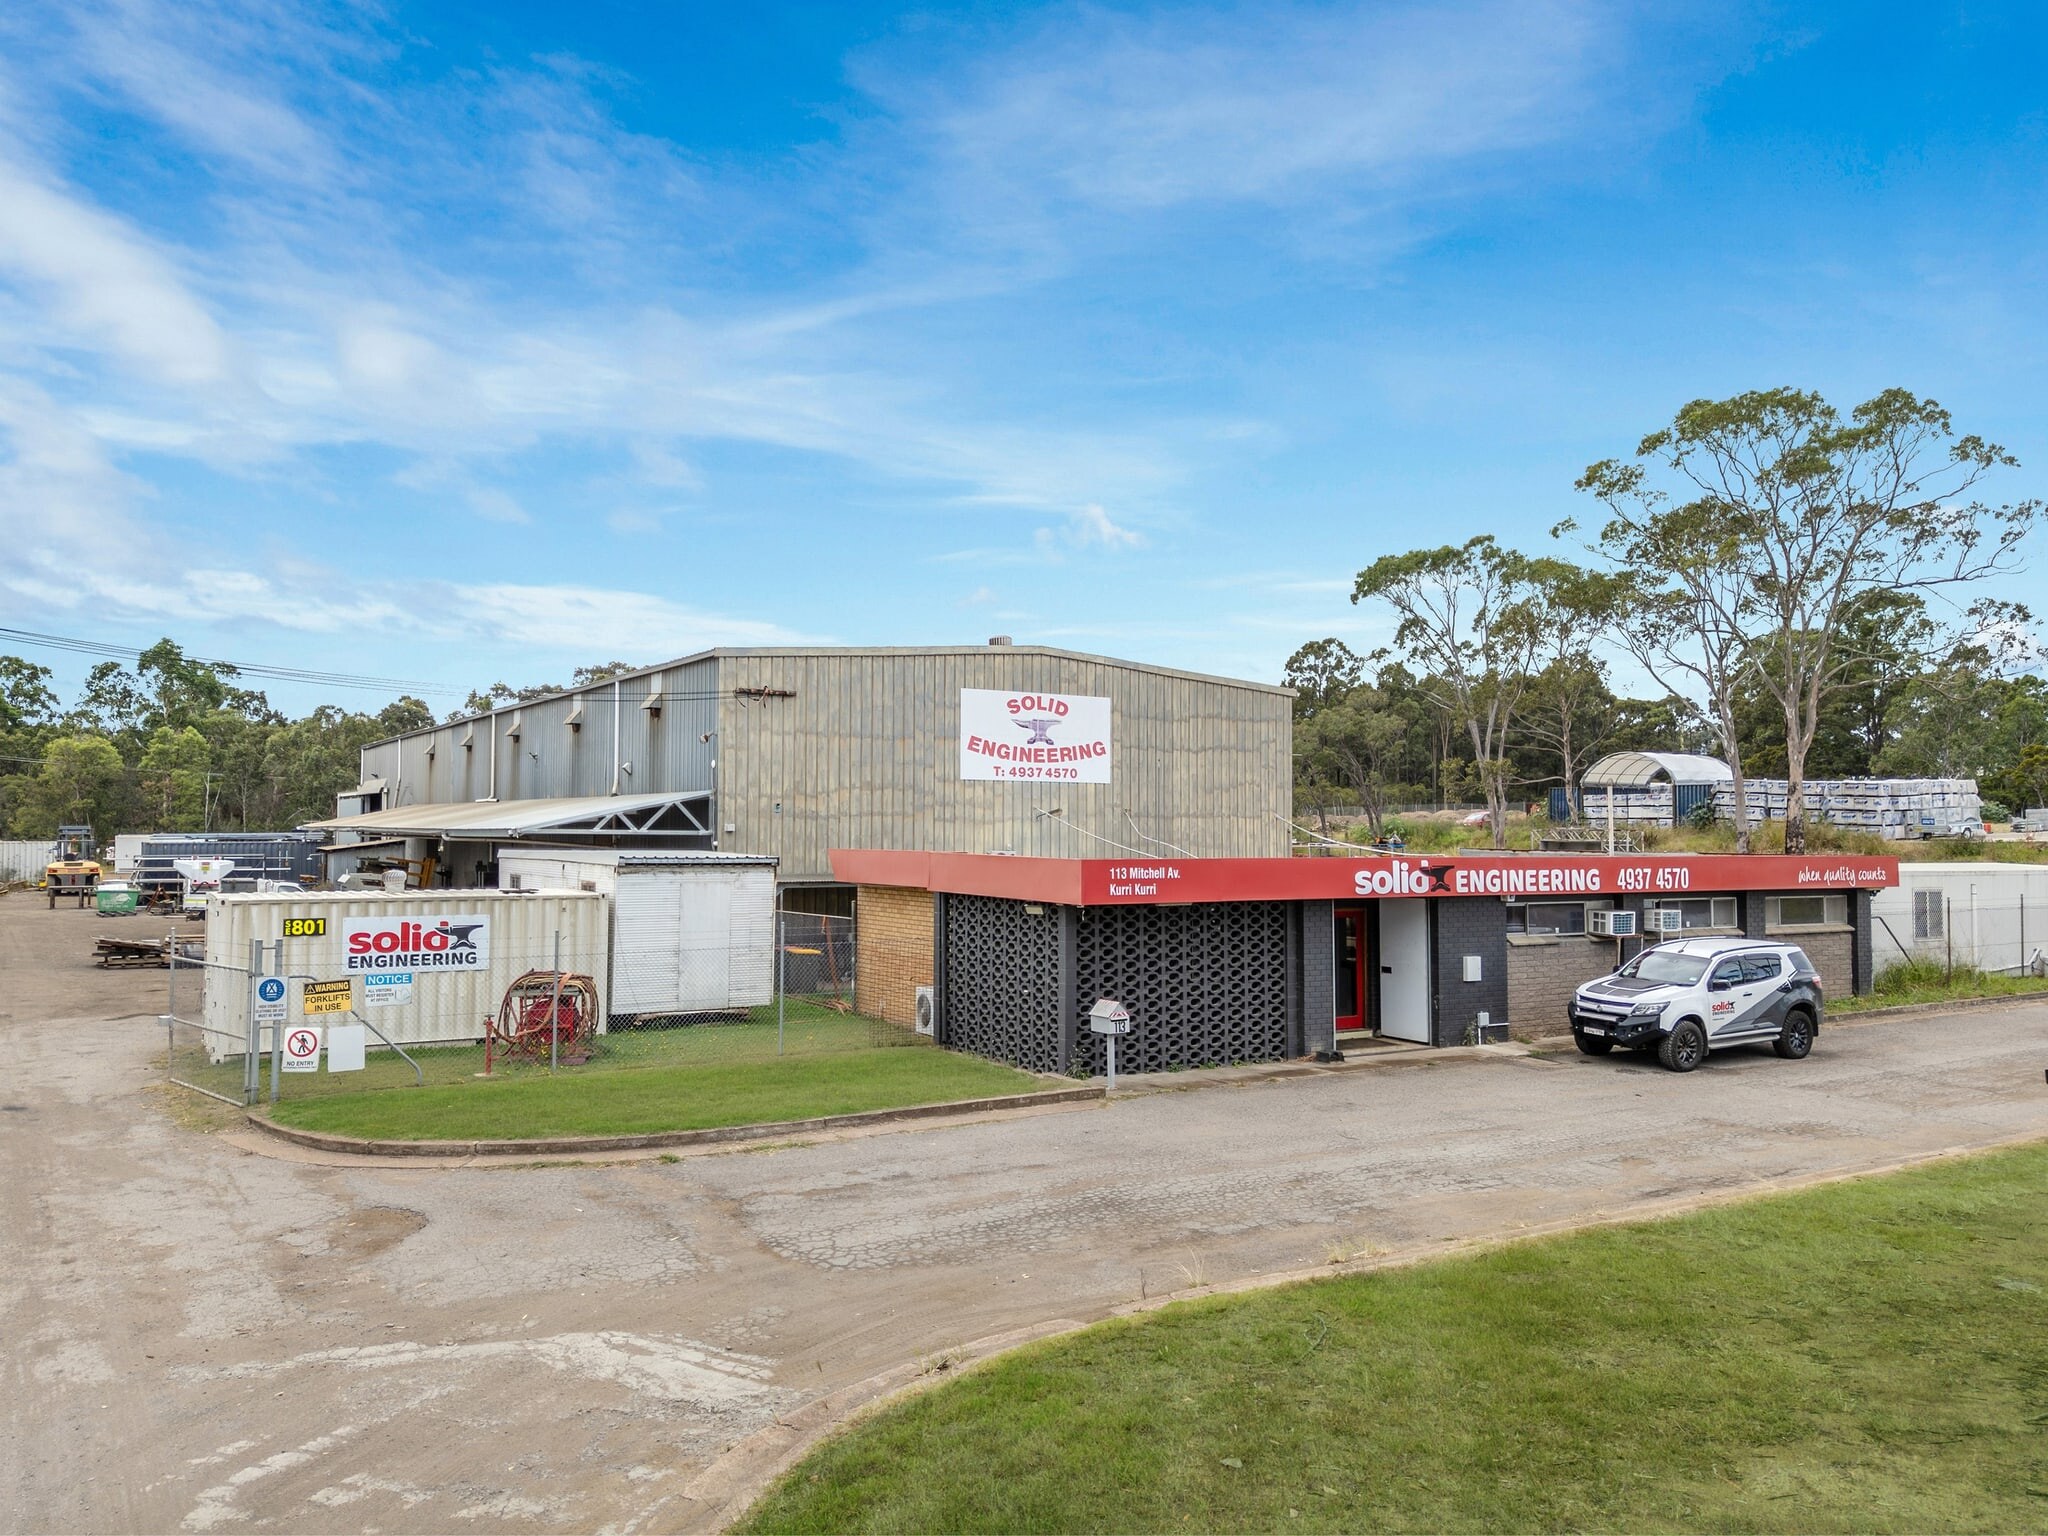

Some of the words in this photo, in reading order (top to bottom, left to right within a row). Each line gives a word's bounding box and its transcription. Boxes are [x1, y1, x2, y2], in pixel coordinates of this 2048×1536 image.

[1006, 695, 1069, 717] SOLID
[966, 735, 1107, 764] ENGINEERING
[993, 766, 1005, 777] T:
[1009, 767, 1043, 778] 4937
[1045, 768, 1078, 779] 4570
[1109, 868, 1127, 880] 113
[1129, 867, 1165, 879] Mitchell
[1167, 867, 1181, 879] Av.
[1354, 859, 1430, 895] solid
[1455, 868, 1601, 893] ENGINEERING
[1617, 868, 1651, 890] 4937
[1655, 867, 1689, 889] 4570
[1798, 866, 1822, 884] when
[1823, 866, 1856, 887] quality
[1857, 866, 1886, 881] counts
[1109, 883, 1132, 896] Kurri
[1134, 883, 1157, 895] Kurri
[291, 919, 324, 936] 801
[348, 920, 449, 955] solid
[347, 951, 478, 969] ENGINEERING
[367, 974, 410, 985] NOTICE
[314, 981, 349, 993] WARNING
[305, 992, 350, 1004] FORKLIFTS
[314, 1004, 323, 1012] IN
[325, 1002, 342, 1011] USE
[1114, 1020, 1126, 1033] 113
